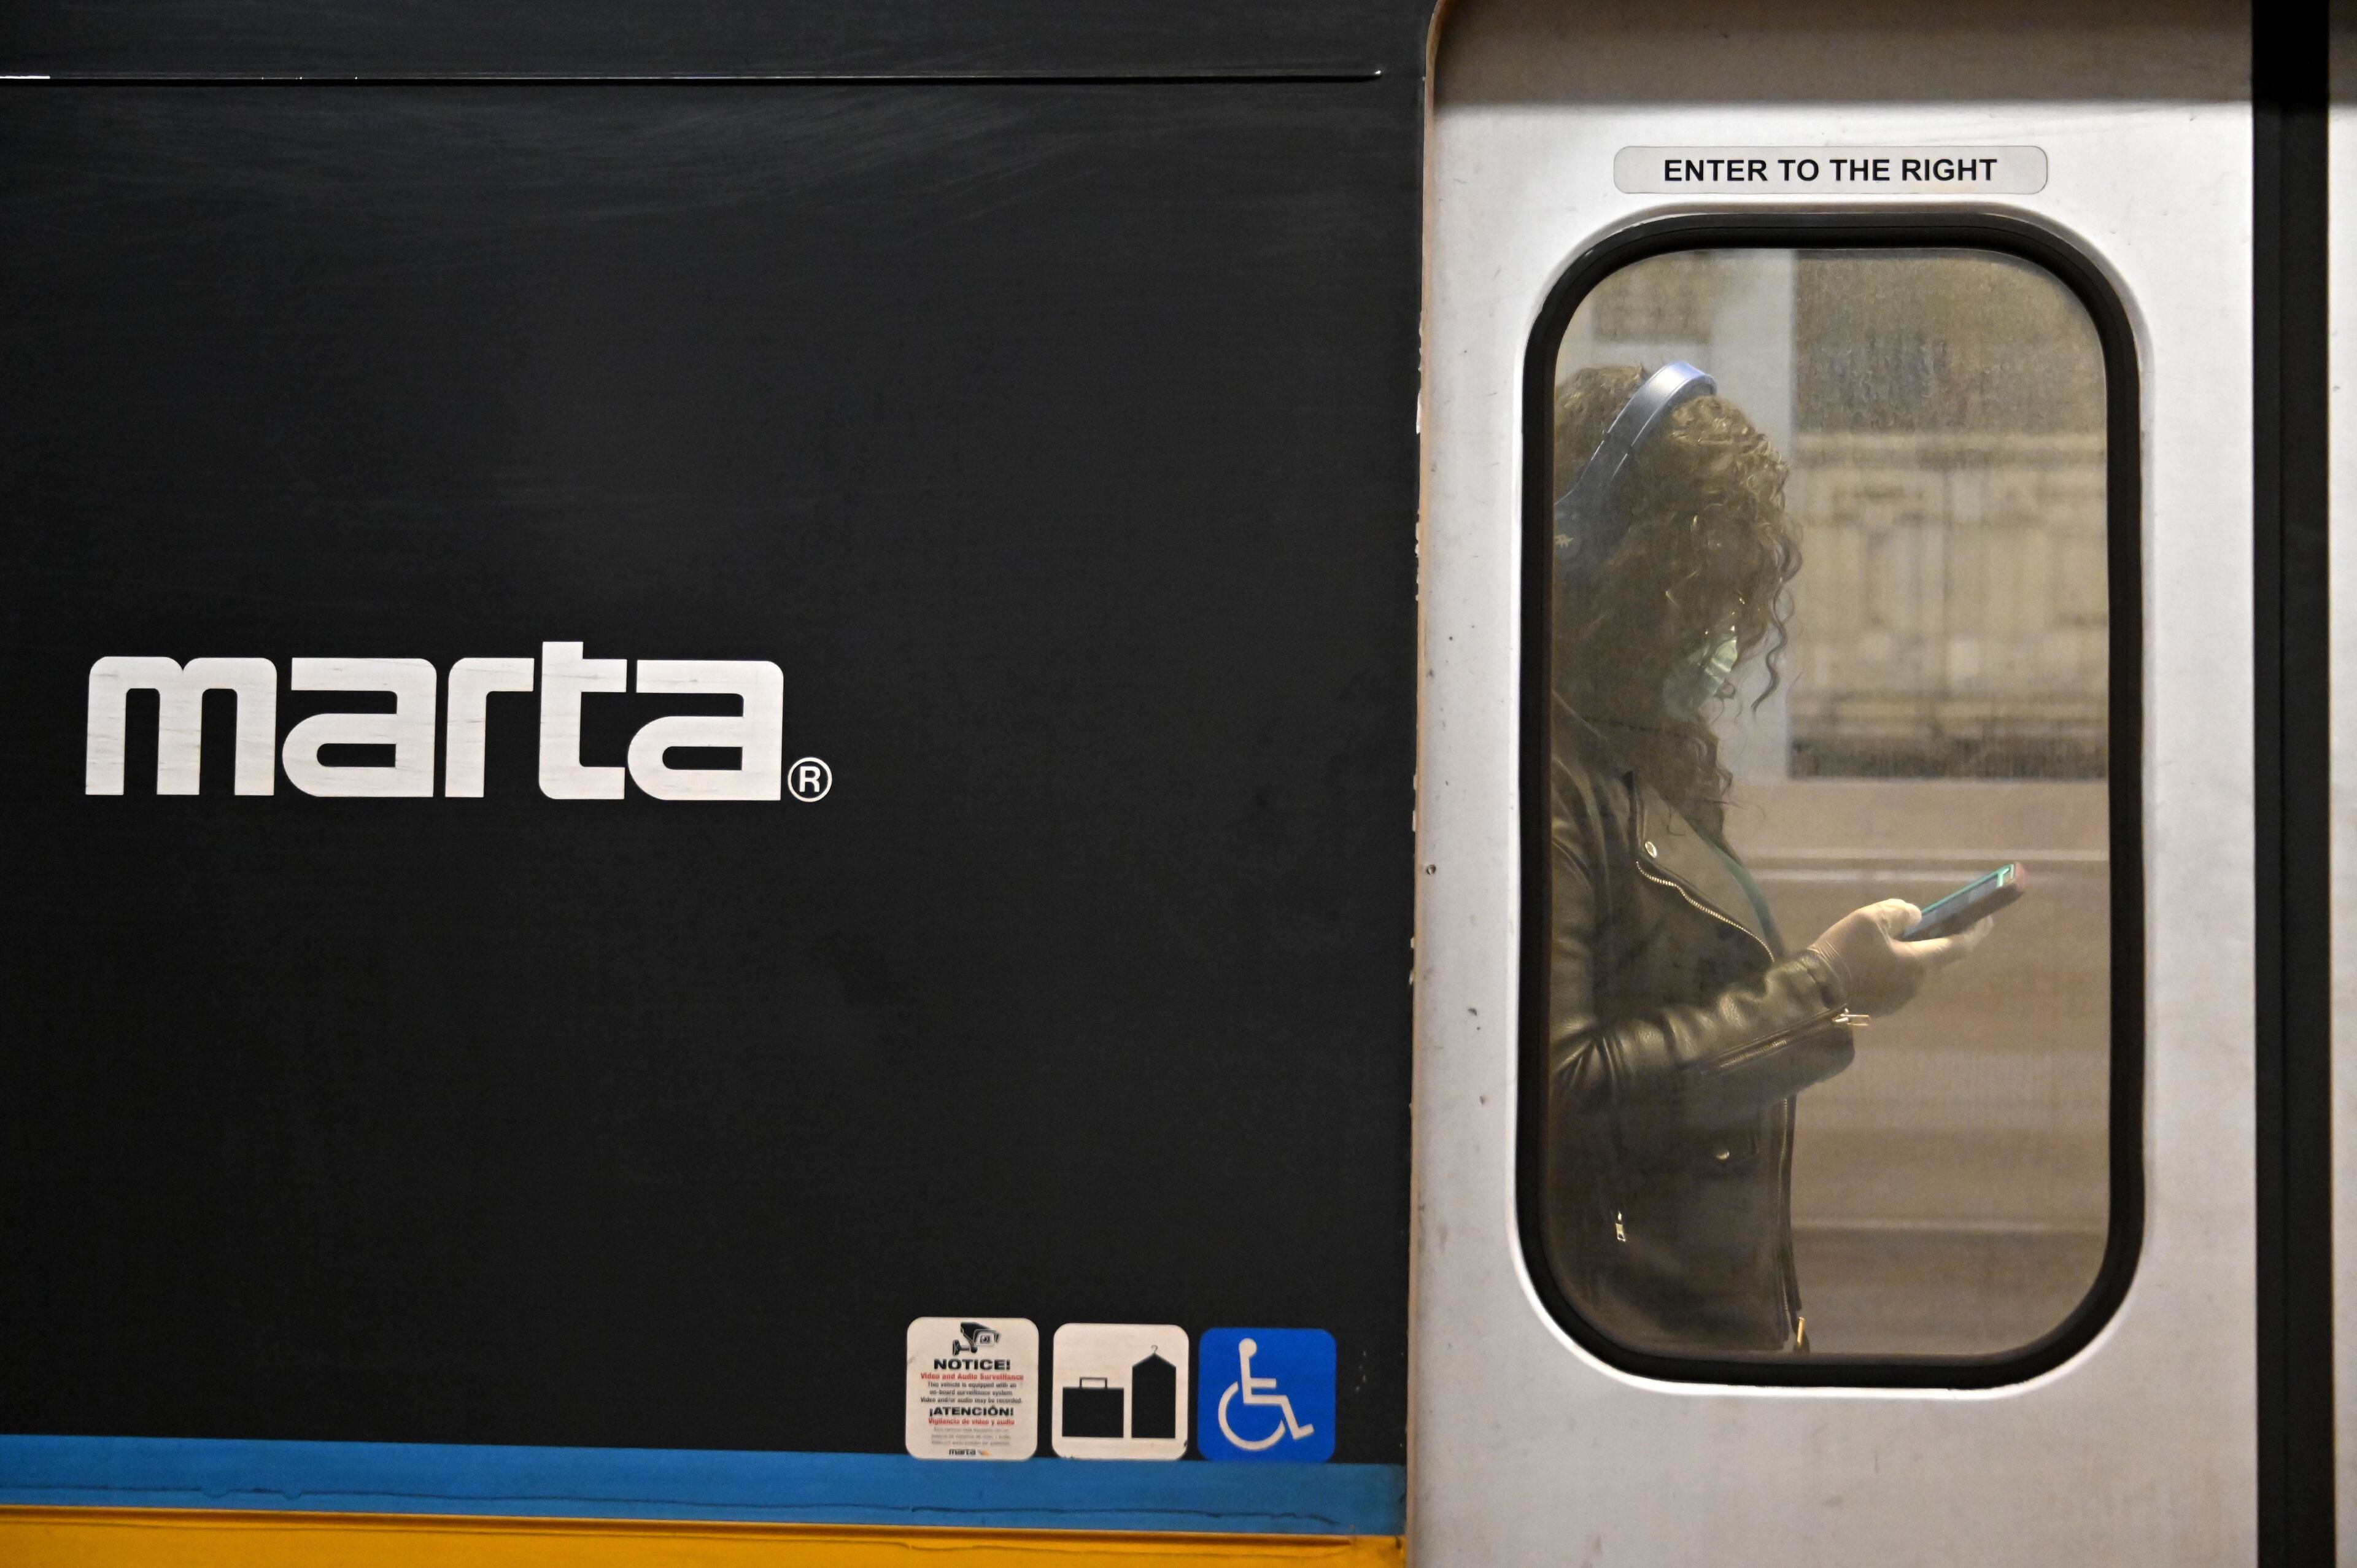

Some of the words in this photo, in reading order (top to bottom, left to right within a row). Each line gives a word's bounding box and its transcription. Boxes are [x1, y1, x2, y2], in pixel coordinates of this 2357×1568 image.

[1664, 159, 1768, 181] ENTER
[1778, 159, 1819, 181] TO
[1830, 159, 1891, 181] THE
[1902, 158, 1998, 181] RIGHT
[934, 1359, 1010, 1370] NOTICE!
[929, 1405, 1013, 1416] ¡ATENCIÓN!
